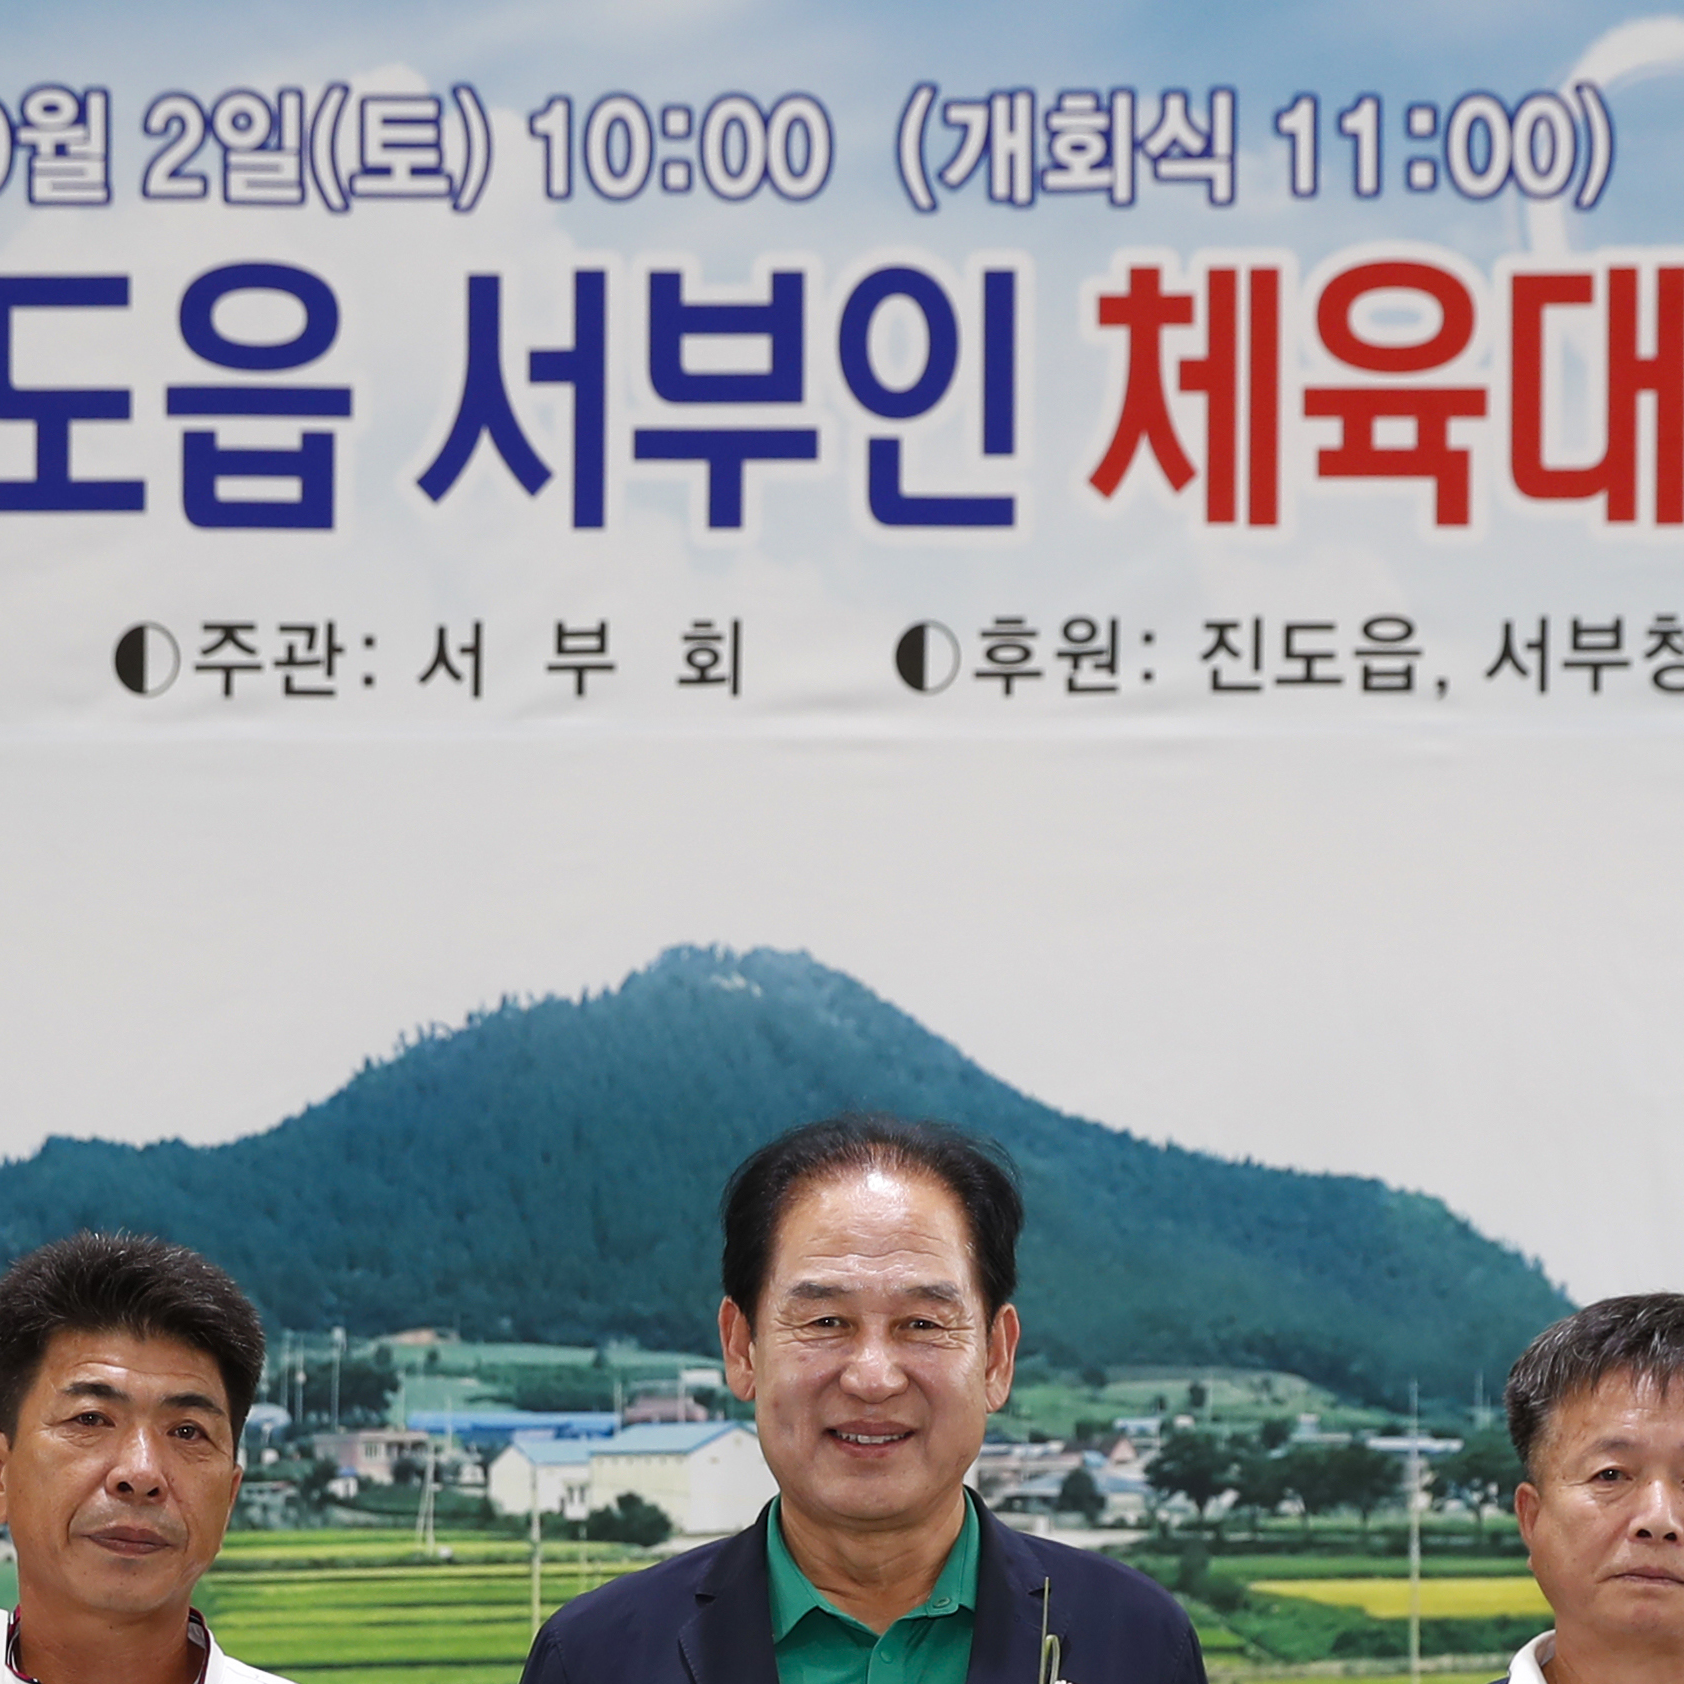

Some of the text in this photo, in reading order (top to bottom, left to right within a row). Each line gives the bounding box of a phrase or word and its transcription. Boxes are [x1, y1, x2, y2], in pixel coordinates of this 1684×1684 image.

[143, 81, 493, 214] 2일(토)
[530, 91, 834, 202] 10:00
[898, 81, 1236, 212] (개회식
[1276, 80, 1614, 210] 11:00)
[415, 265, 1015, 530] 서부인
[193, 620, 375, 700] 주관:
[974, 616, 1154, 696] 후원:
[1199, 614, 1449, 701] 진도읍,
